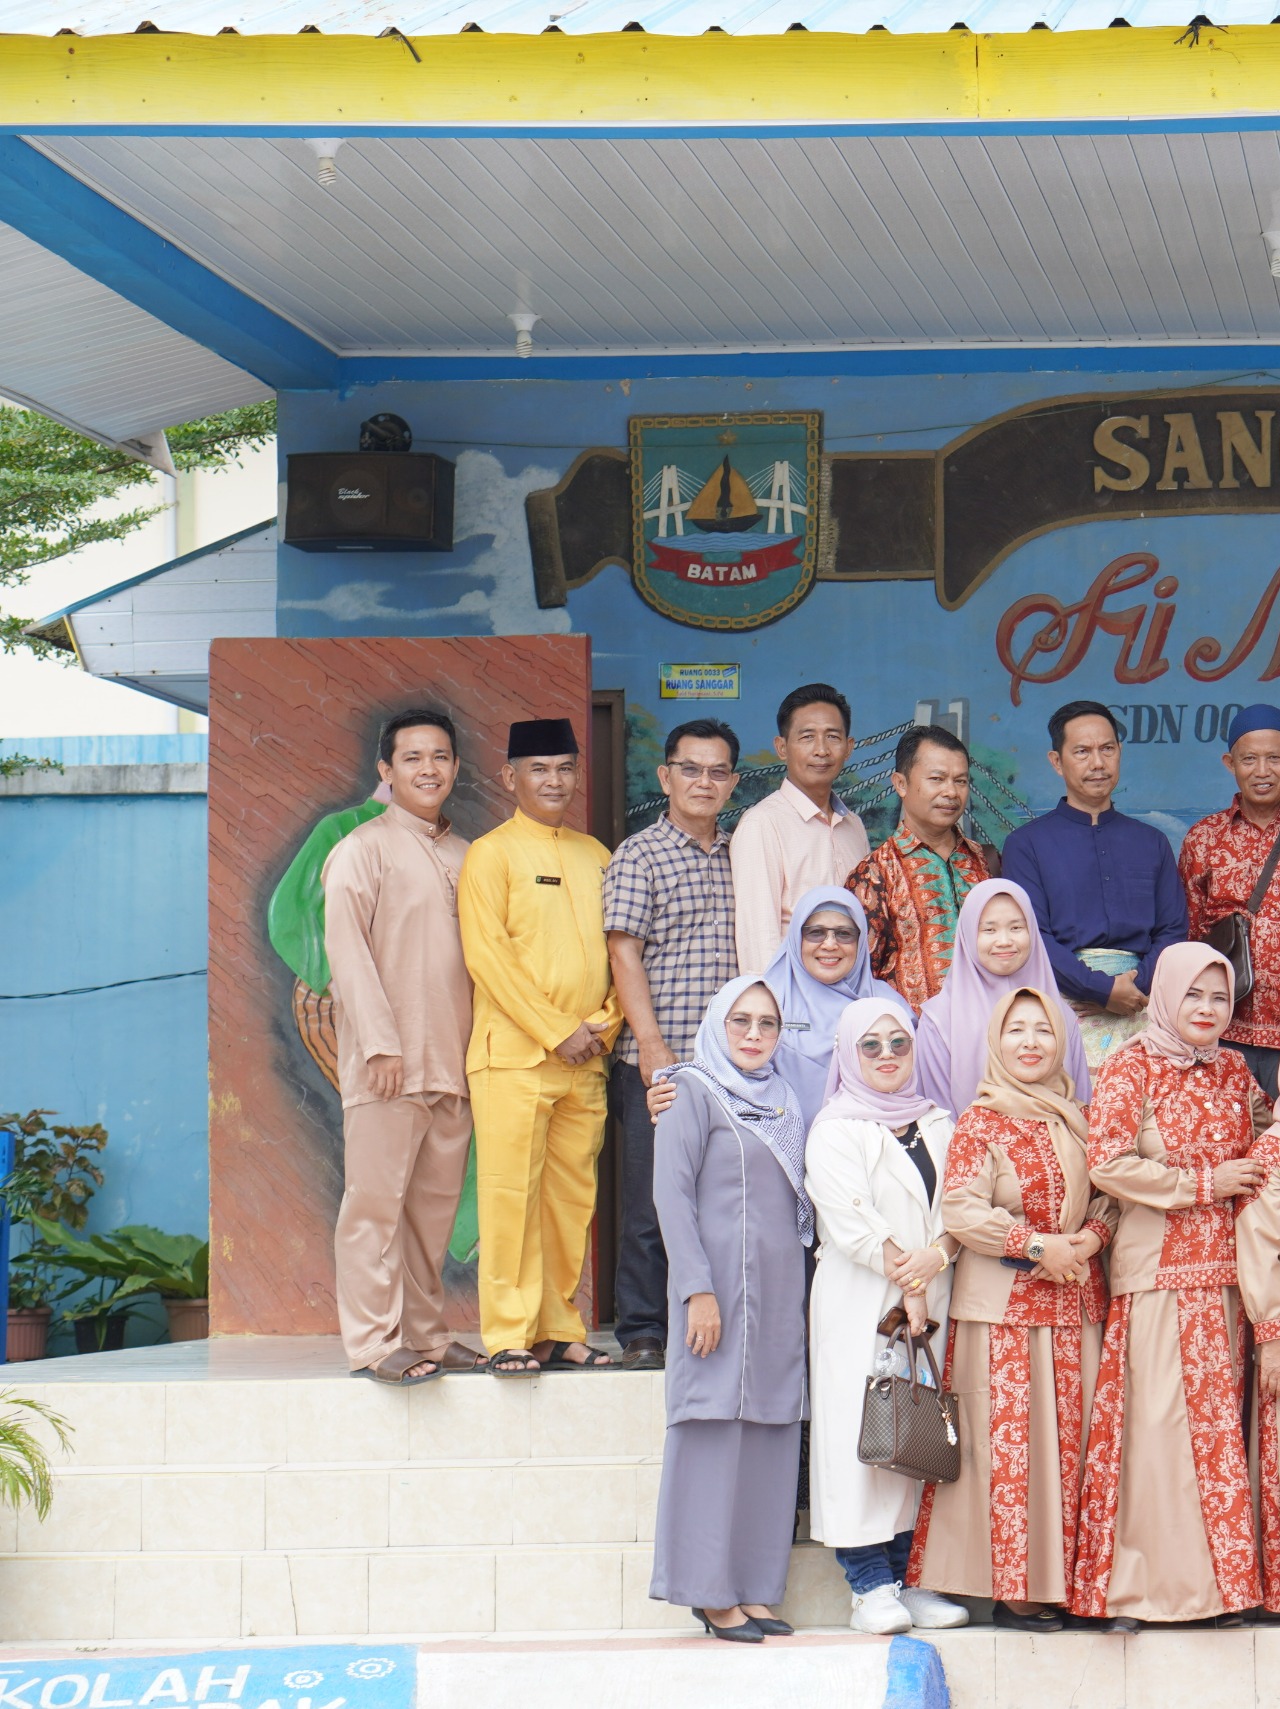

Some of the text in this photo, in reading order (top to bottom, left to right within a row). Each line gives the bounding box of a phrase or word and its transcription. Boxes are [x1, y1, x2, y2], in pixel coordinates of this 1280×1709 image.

[337, 487, 360, 495] Black
[687, 563, 757, 581] BATAM
[680, 669, 702, 677] RUANG
[704, 669, 720, 677] 0033
[666, 680, 733, 690] RUANG SANGGAR
